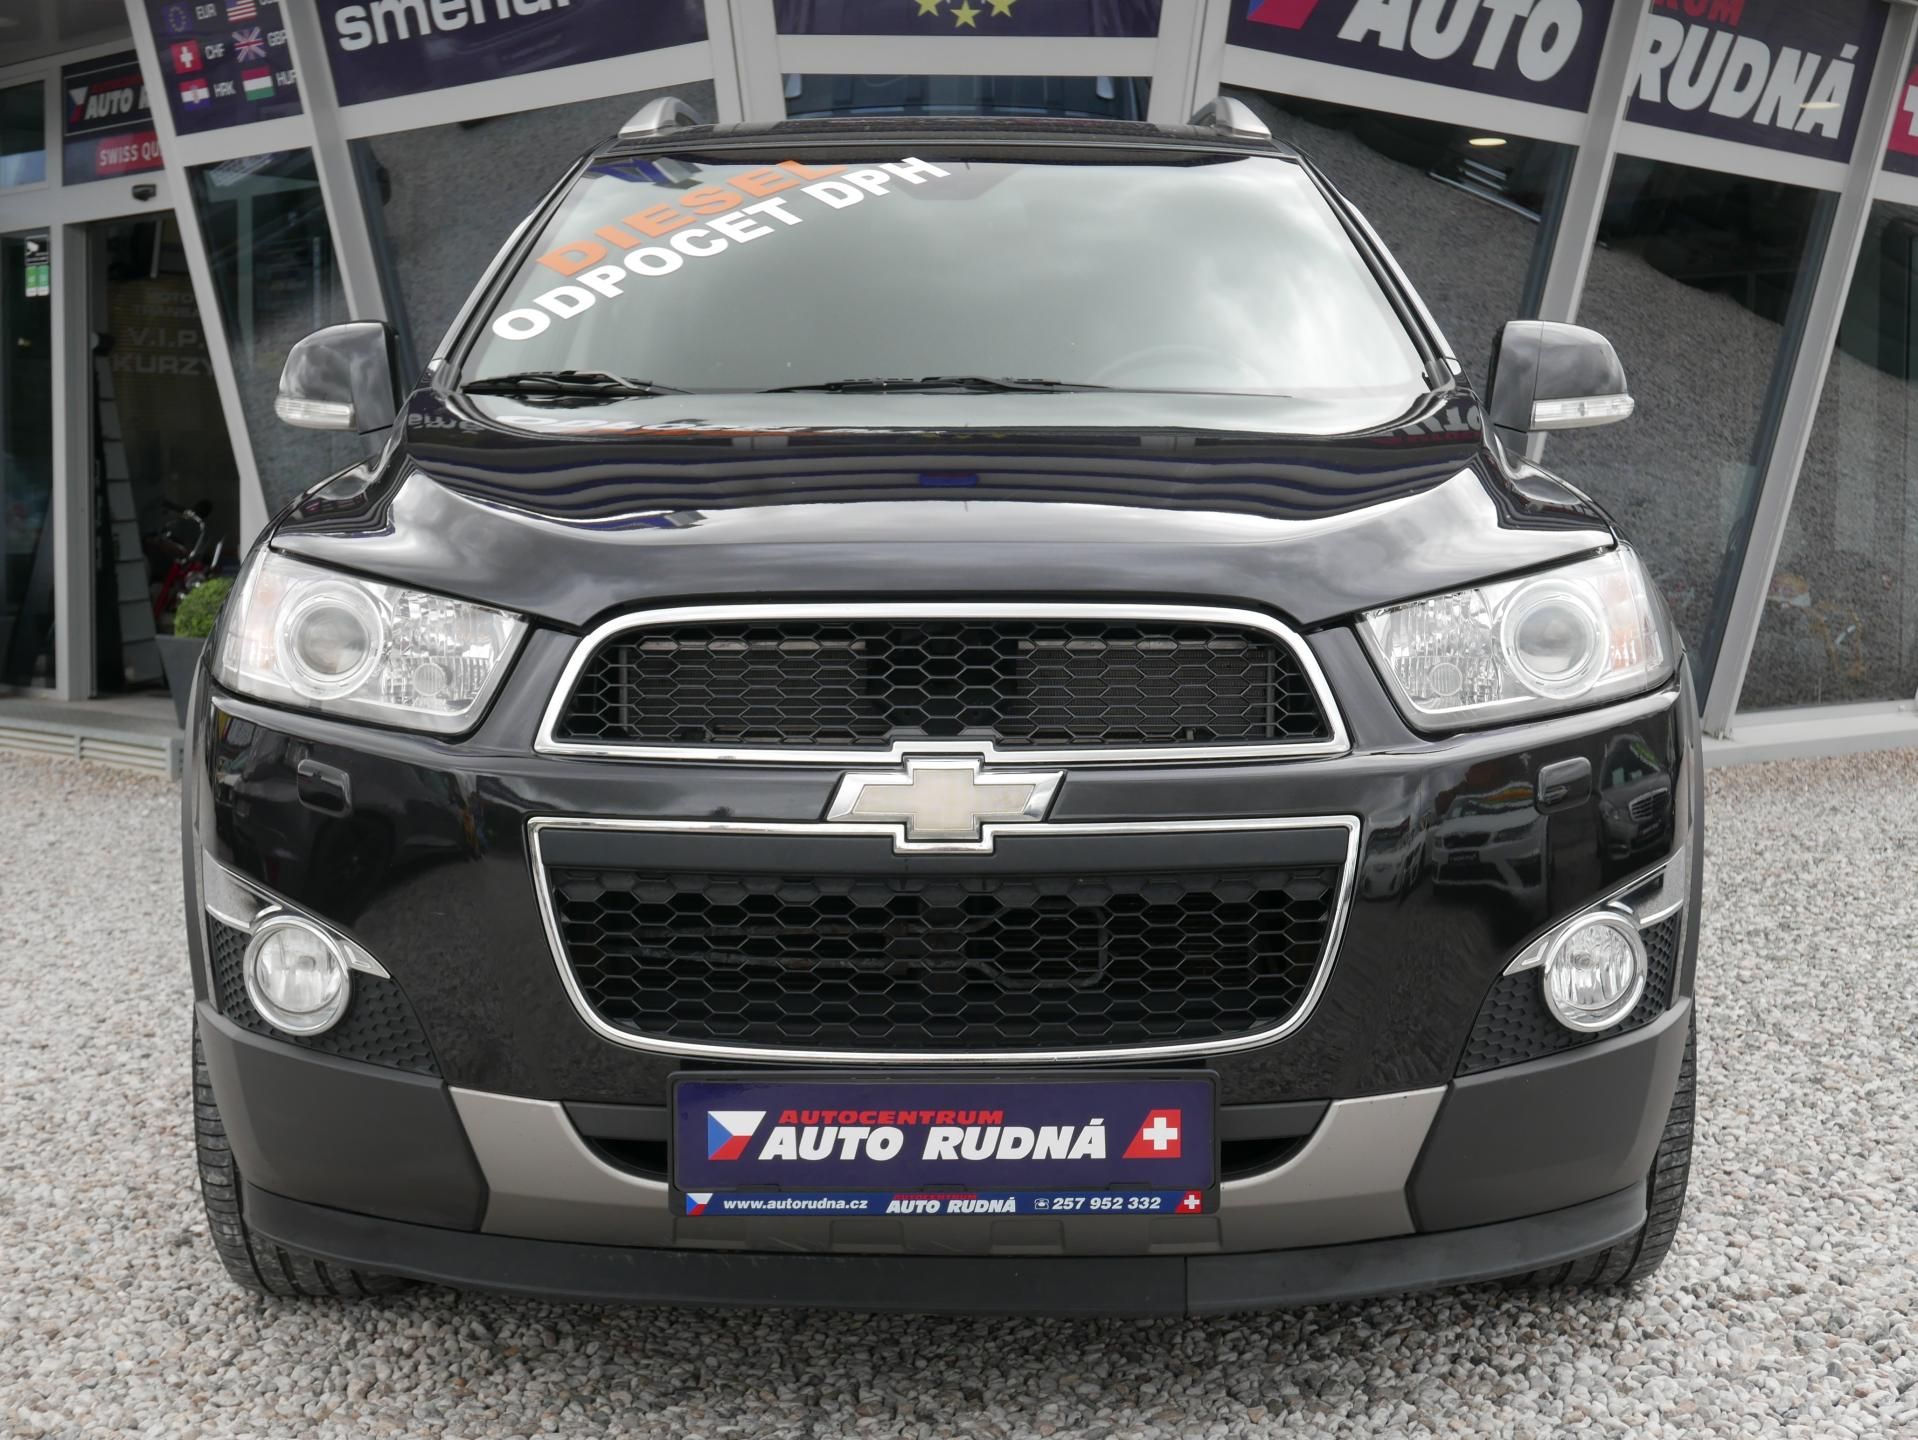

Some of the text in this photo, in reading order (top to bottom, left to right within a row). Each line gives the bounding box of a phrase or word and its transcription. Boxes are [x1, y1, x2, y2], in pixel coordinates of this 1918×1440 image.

[195, 3, 217, 20] EUR
[204, 43, 226, 60] CHF
[1337, 0, 1860, 140] AUTO RUDNÁ
[213, 80, 237, 98] HRK
[84, 88, 134, 120] AUTO
[100, 144, 139, 167] SWISS
[536, 160, 849, 277] DIESEL
[492, 156, 951, 341] ODPOCET DPH
[778, 1110, 1004, 1125] AUTOCENTRUM
[758, 1118, 1107, 1161] AUTO RUDNÁ
[723, 1198, 868, 1210] www.autorudna.cz
[885, 1196, 1016, 1214] AUTO RUDNÁ
[1052, 1196, 1162, 1210] 257 952 332
